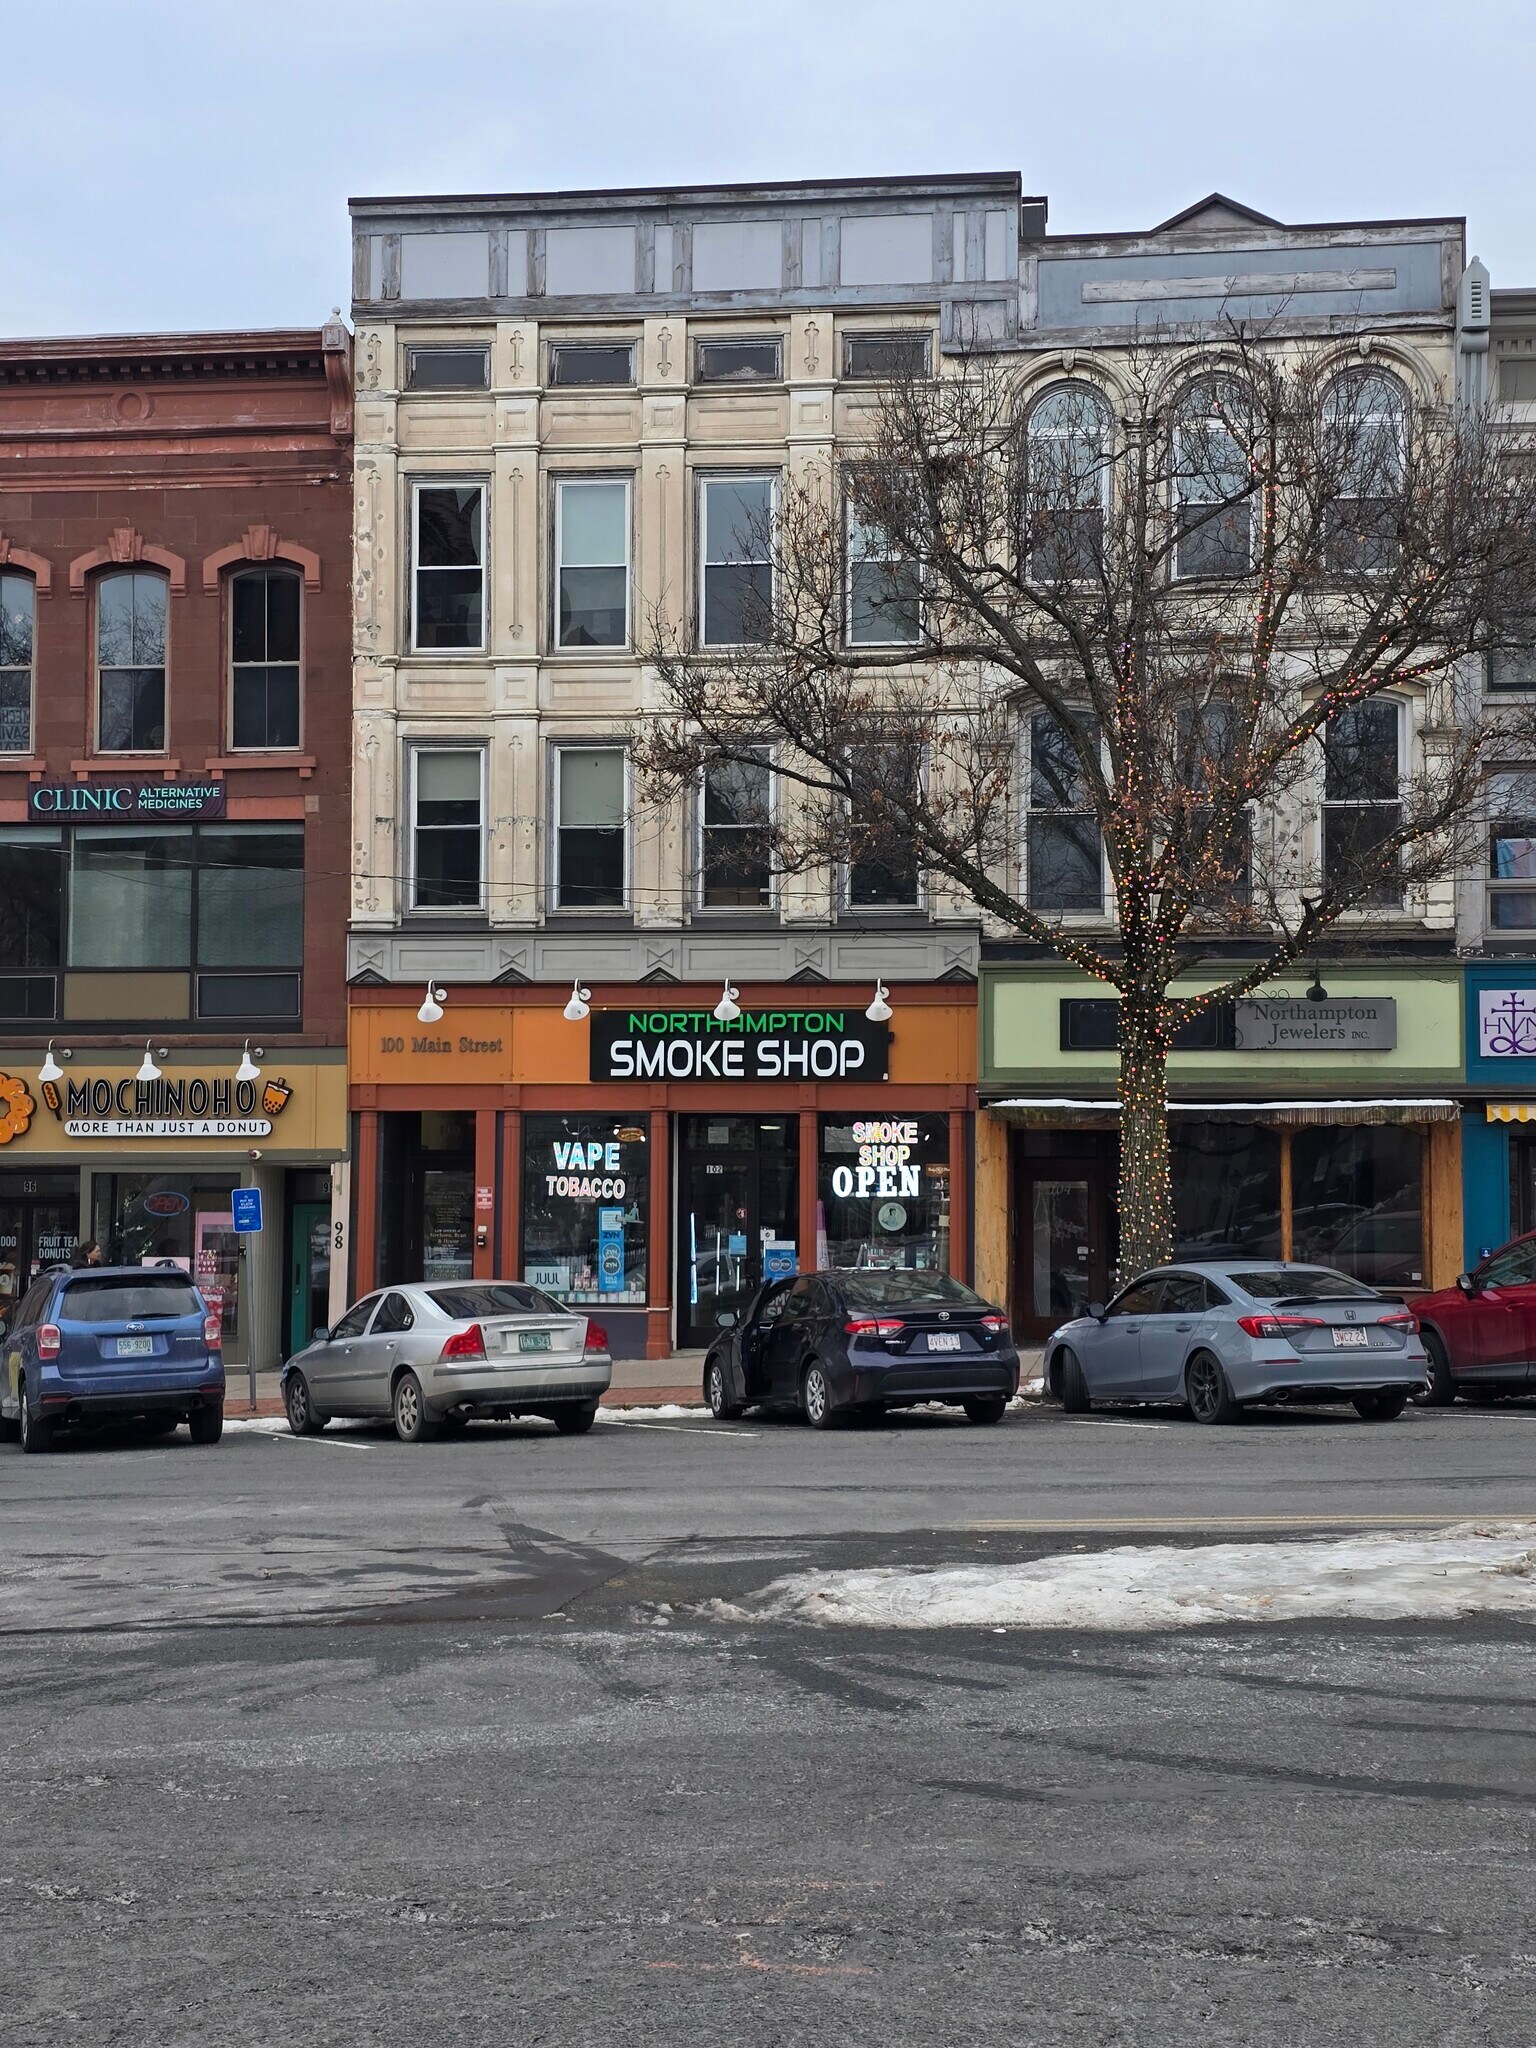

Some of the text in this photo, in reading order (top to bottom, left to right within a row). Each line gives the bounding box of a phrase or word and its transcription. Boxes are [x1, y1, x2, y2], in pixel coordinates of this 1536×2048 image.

[33, 788, 133, 811] CLINIC
[139, 787, 220, 798] ALTERNATIVE
[138, 799, 203, 809] MEDICINES
[1254, 1004, 1378, 1026] Northampton
[629, 1013, 845, 1033] NORTHAMPTON
[1267, 1023, 1370, 1045] Jewelers INC.
[381, 1036, 503, 1053] 100 Main Street
[610, 1039, 865, 1077] SMOKE SHOP
[66, 1078, 257, 1116] MOCHINOHO
[69, 1122, 267, 1133] MORE THAN JUST A DONUT
[852, 1122, 919, 1144] SMOKE
[552, 1142, 621, 1171] VAPE
[858, 1145, 911, 1167] SHOP
[706, 1165, 723, 1174] 102
[24, 1181, 37, 1192] 96
[545, 1175, 626, 1200] TOBACCO
[832, 1165, 921, 1198] OPEN
[0, 1236, 17, 1247] DOG
[39, 1236, 79, 1247] FRUIT TEA
[39, 1248, 71, 1259] DONUTS
[535, 1272, 560, 1285] JUUL
[135, 1340, 151, 1349] 9200
[950, 1337, 960, 1346] 13
[1355, 1332, 1365, 1342] 23
